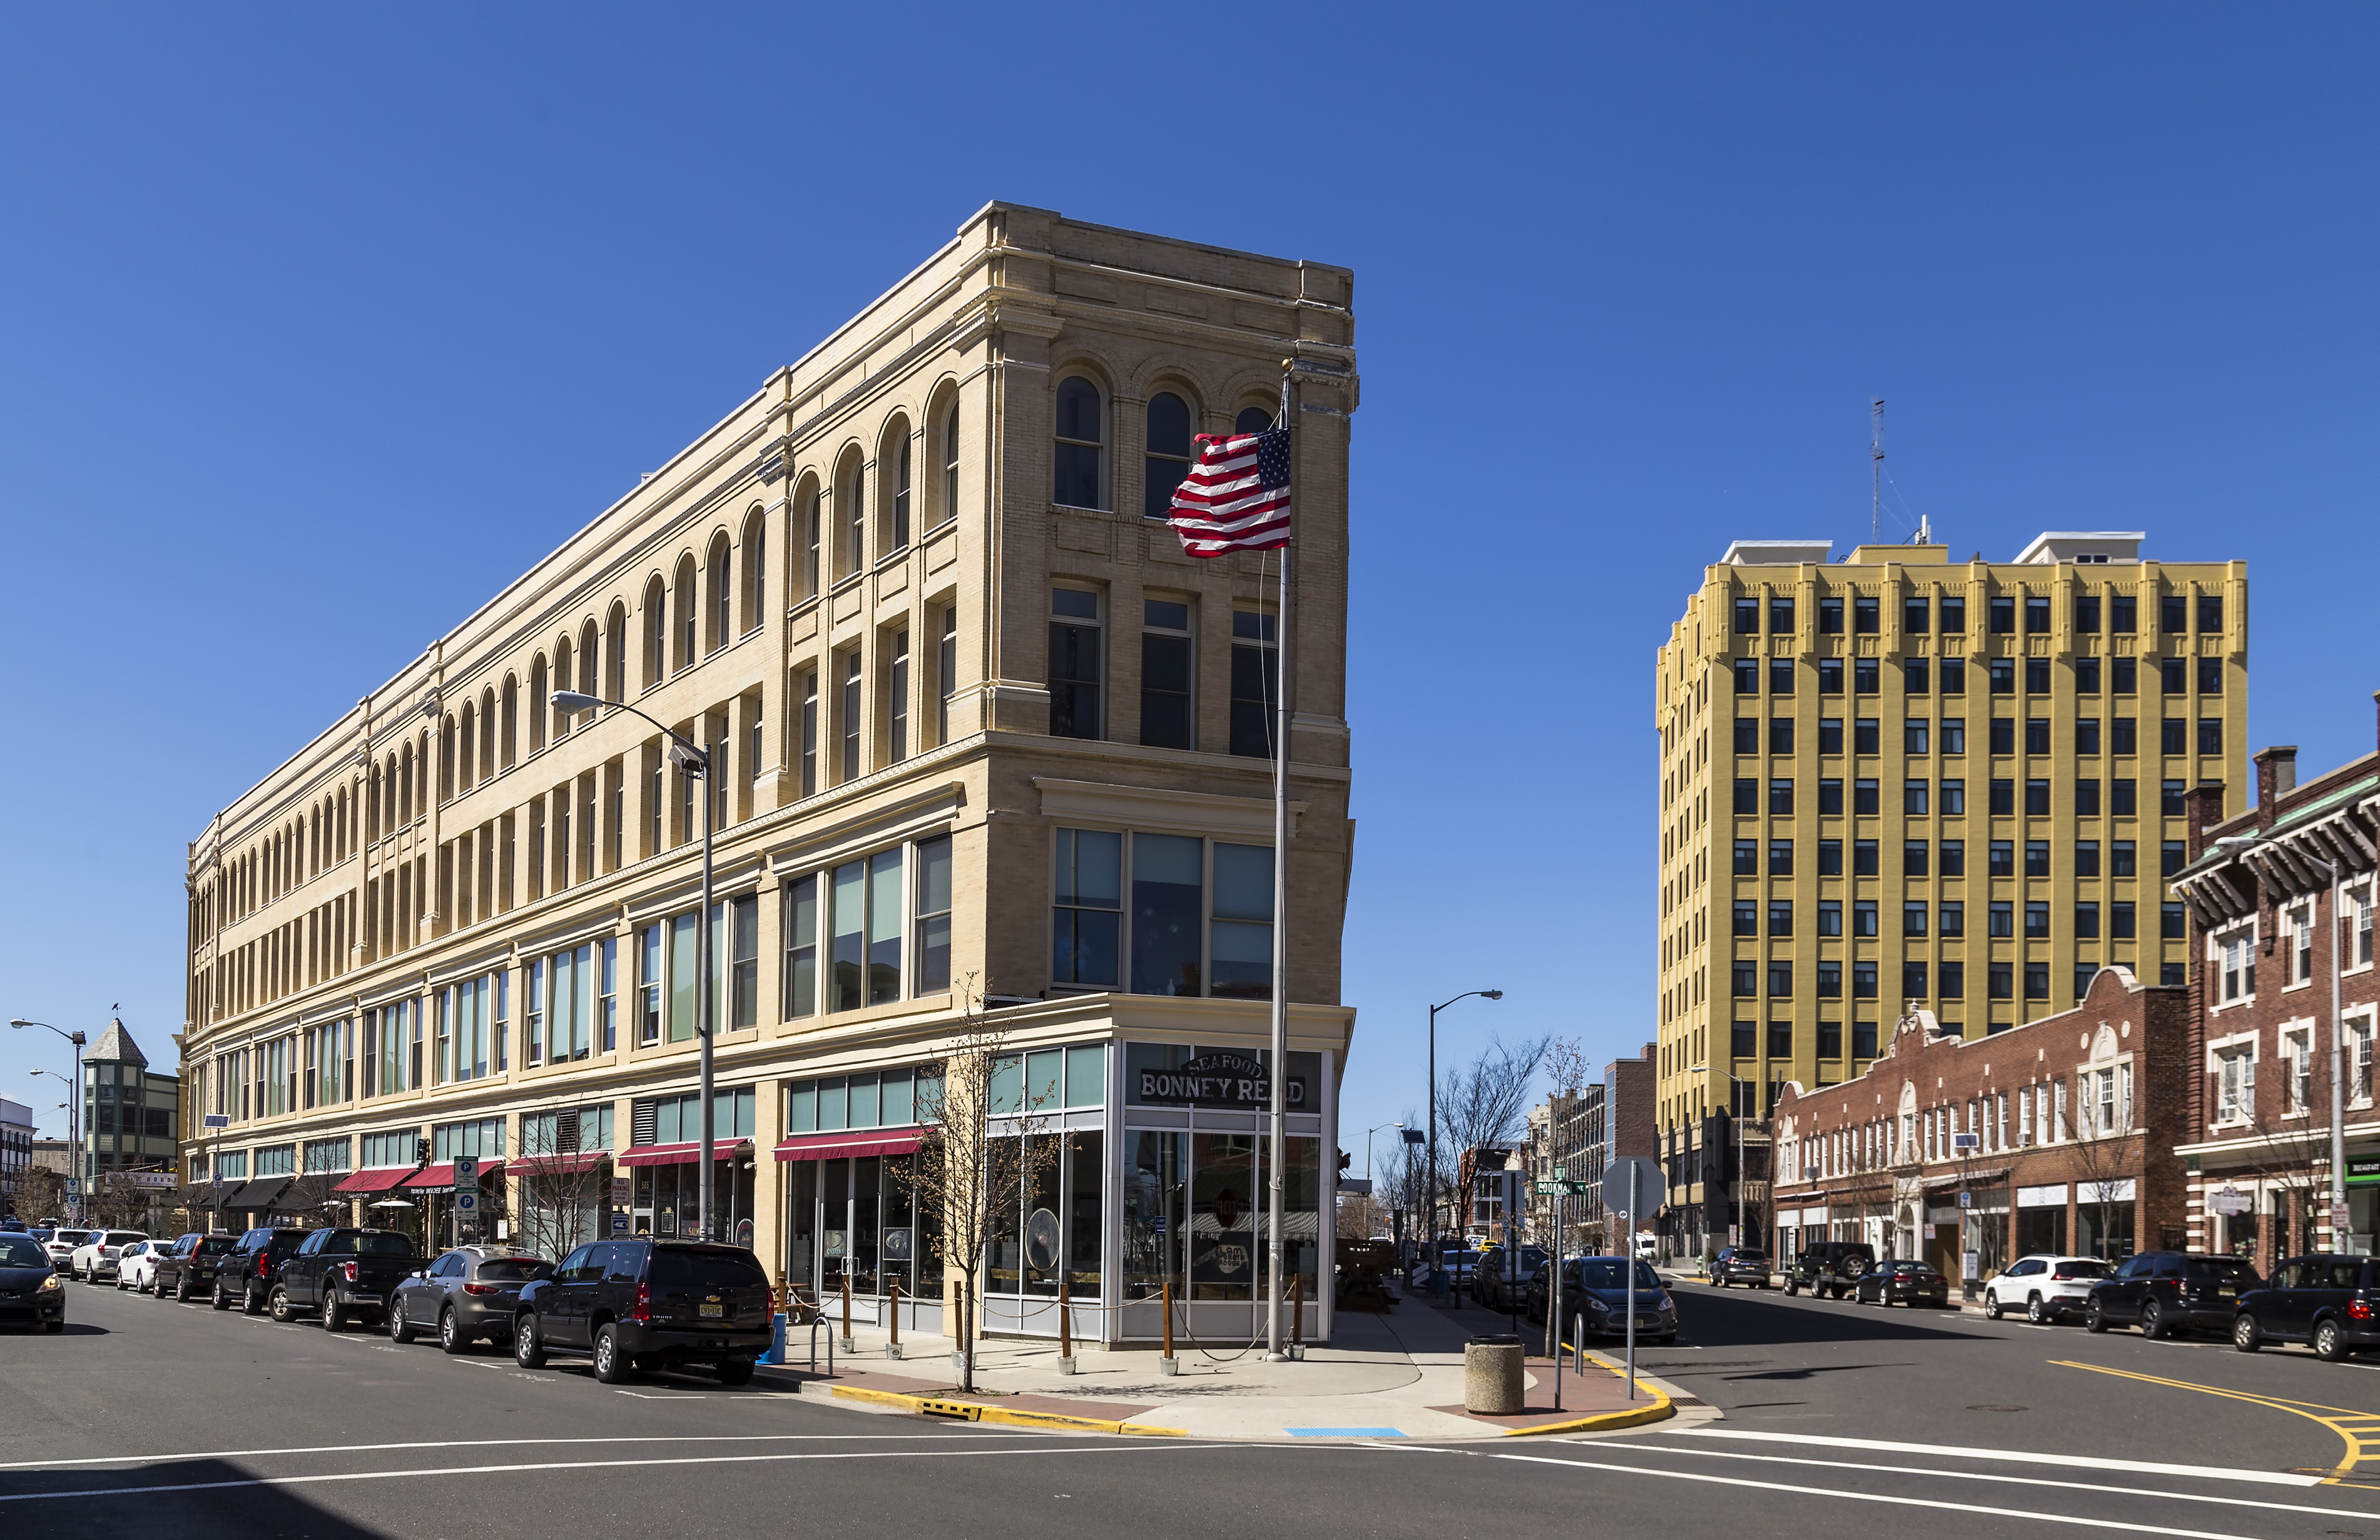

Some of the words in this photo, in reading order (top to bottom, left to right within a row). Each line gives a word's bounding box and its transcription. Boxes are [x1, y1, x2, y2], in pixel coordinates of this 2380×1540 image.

[1187, 1055, 1263, 1078] SEAFOOD
[1141, 1073, 1232, 1098] BONNEY
[1238, 1079, 1304, 1102] RED
[1538, 1182, 1572, 1193] COOKMAN
